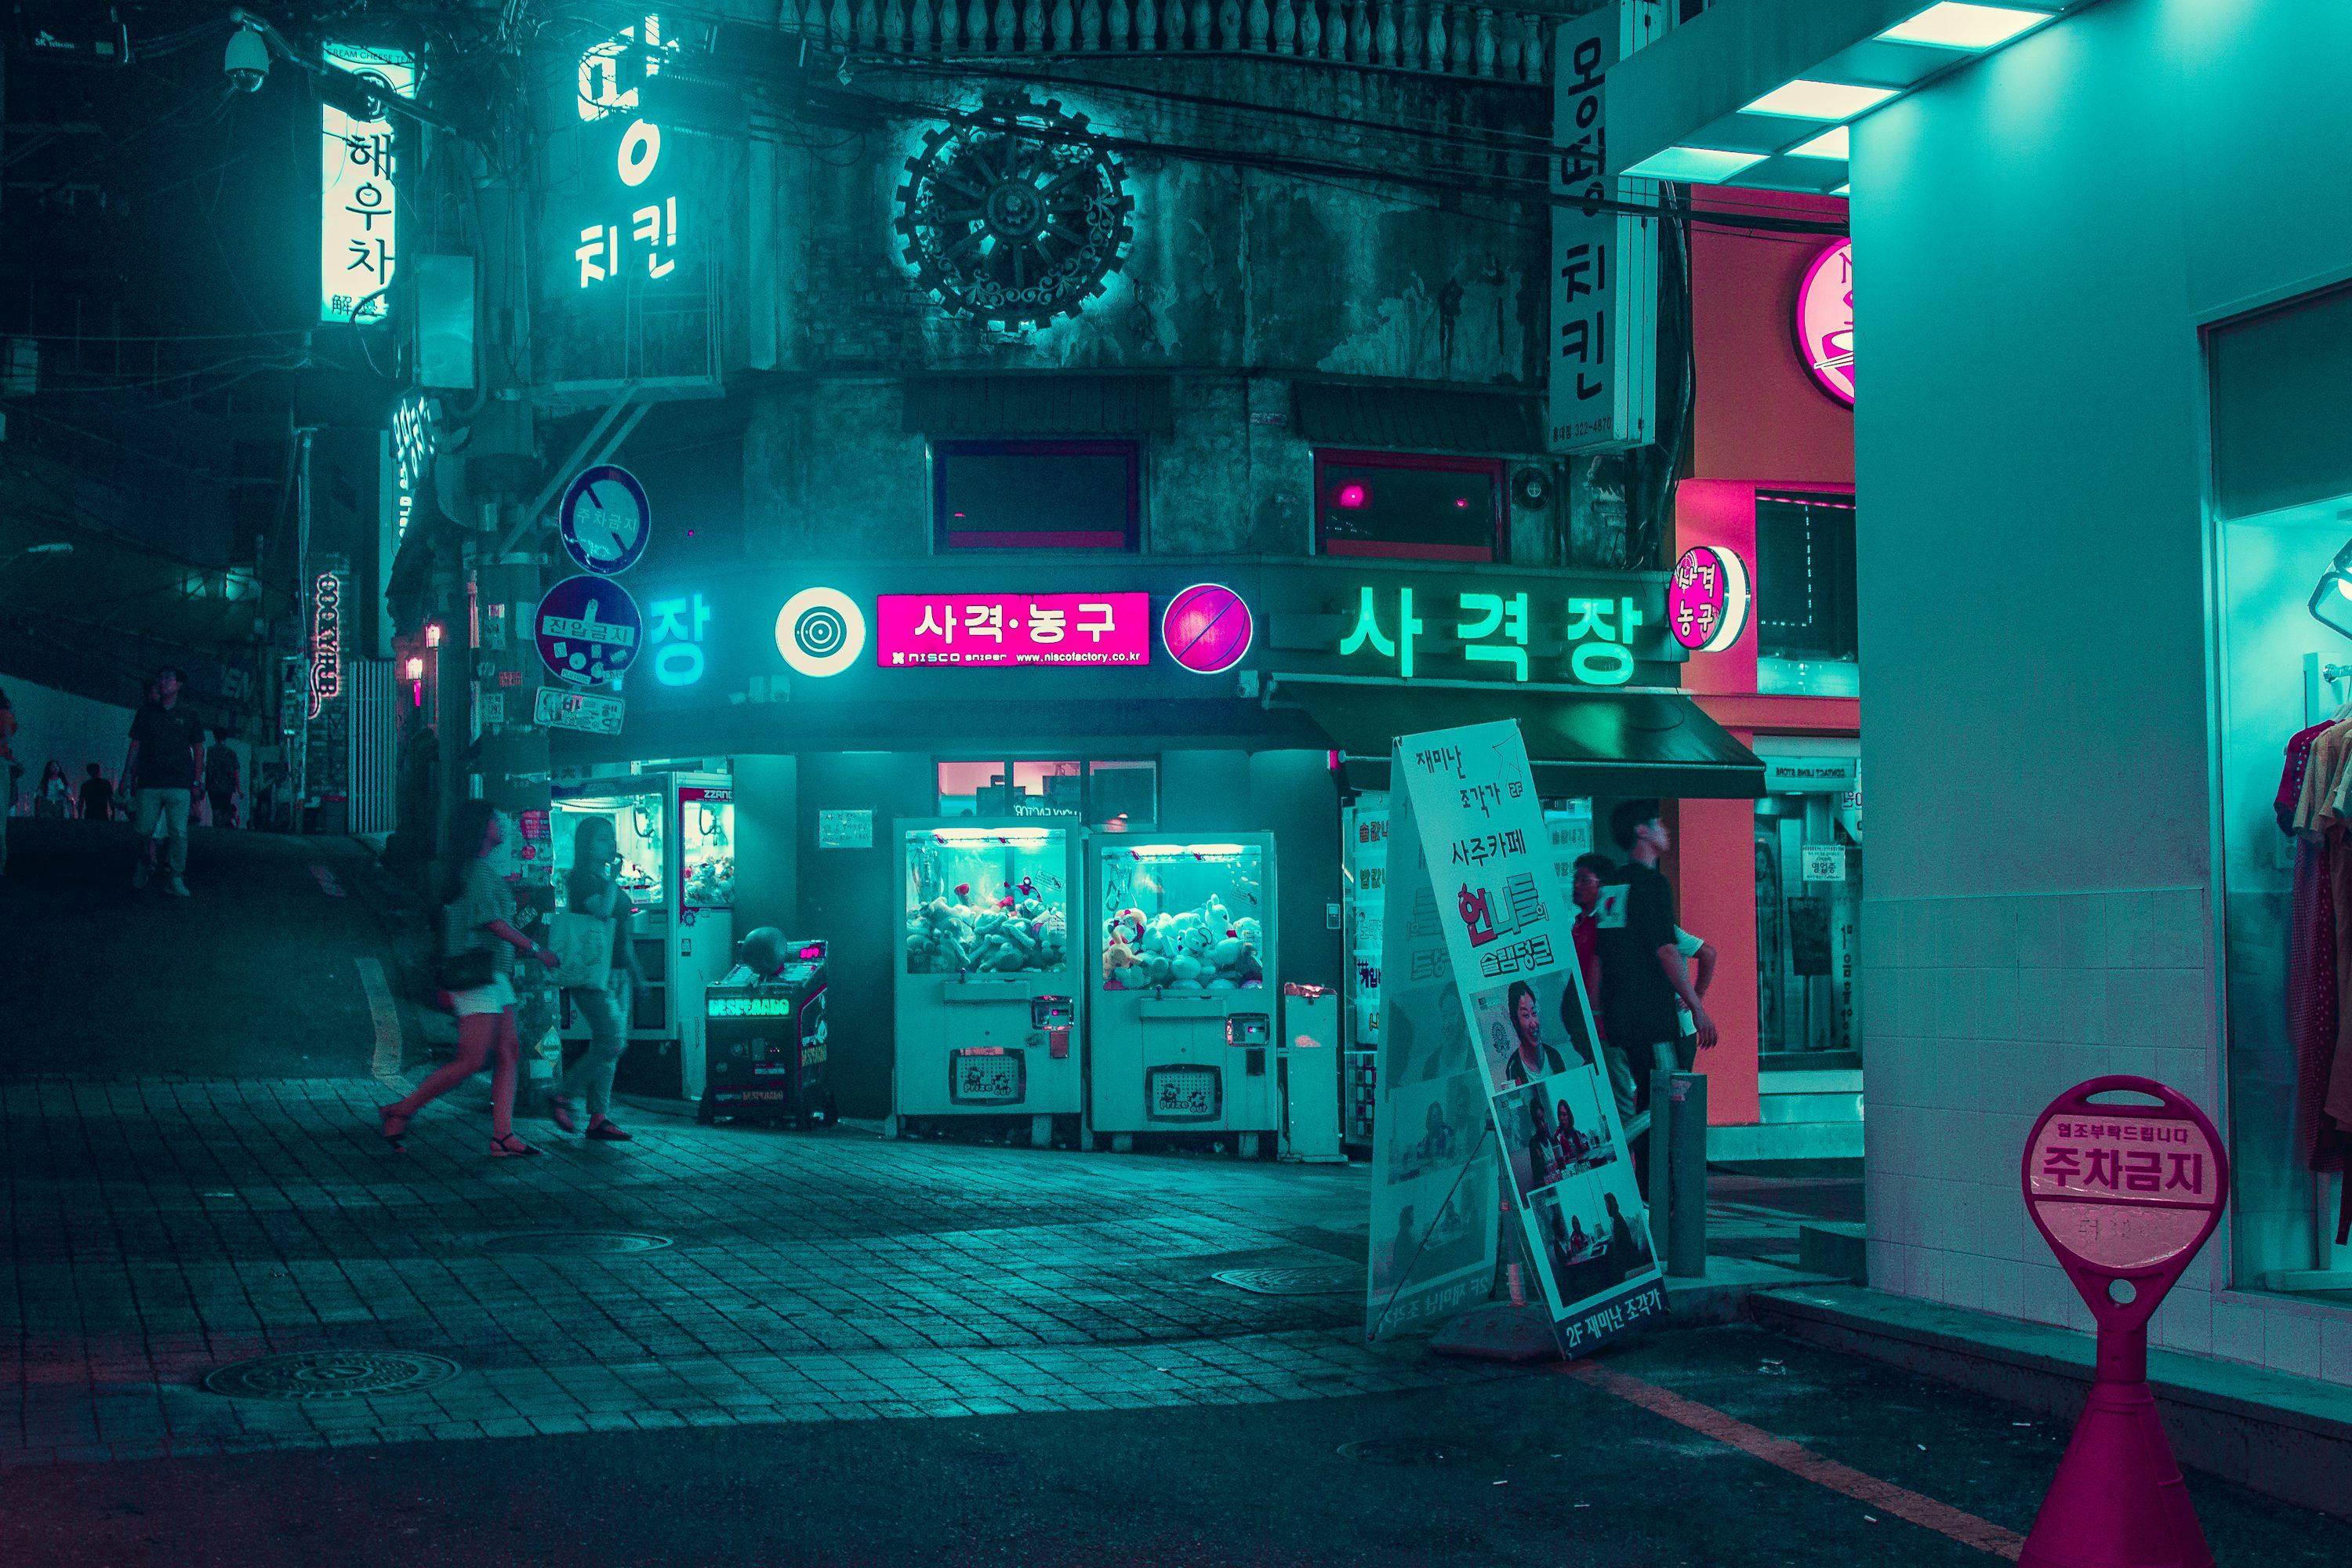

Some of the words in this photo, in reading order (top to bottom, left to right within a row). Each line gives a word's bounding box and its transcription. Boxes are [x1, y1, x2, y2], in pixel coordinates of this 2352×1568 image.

[327, 49, 358, 58] CREAM
[361, 52, 393, 62] CHEESE
[346, 134, 395, 285] 해우차
[575, 196, 677, 289] 치킨
[1562, 245, 1606, 401] 치킨
[1575, 416, 1612, 437] 322-4870
[575, 508, 637, 534] 주차금지
[1678, 563, 1715, 598] 사격
[550, 618, 628, 644] 진입금지
[1340, 586, 1642, 685] 사격장
[1677, 600, 1715, 637] 농구
[651, 593, 710, 687] 장
[1016, 652, 1141, 663] www.niscofactory.co.kr
[1416, 745, 1466, 779] 재미난
[1460, 782, 1501, 818] 조각가
[1508, 781, 1523, 798] 2F
[1452, 828, 1526, 867] 사주카페
[1811, 862, 1836, 874] 영업중
[1480, 935, 1555, 978] 슬램덩크
[1160, 1098, 1189, 1109] Prize
[2057, 1123, 2188, 1144] 협조부탁드립니다
[2043, 1146, 2202, 1195] 주차금지
[1566, 1322, 1583, 1348] 2F
[1584, 1304, 1624, 1339] 재미난
[1624, 1288, 1661, 1320] 조각가
